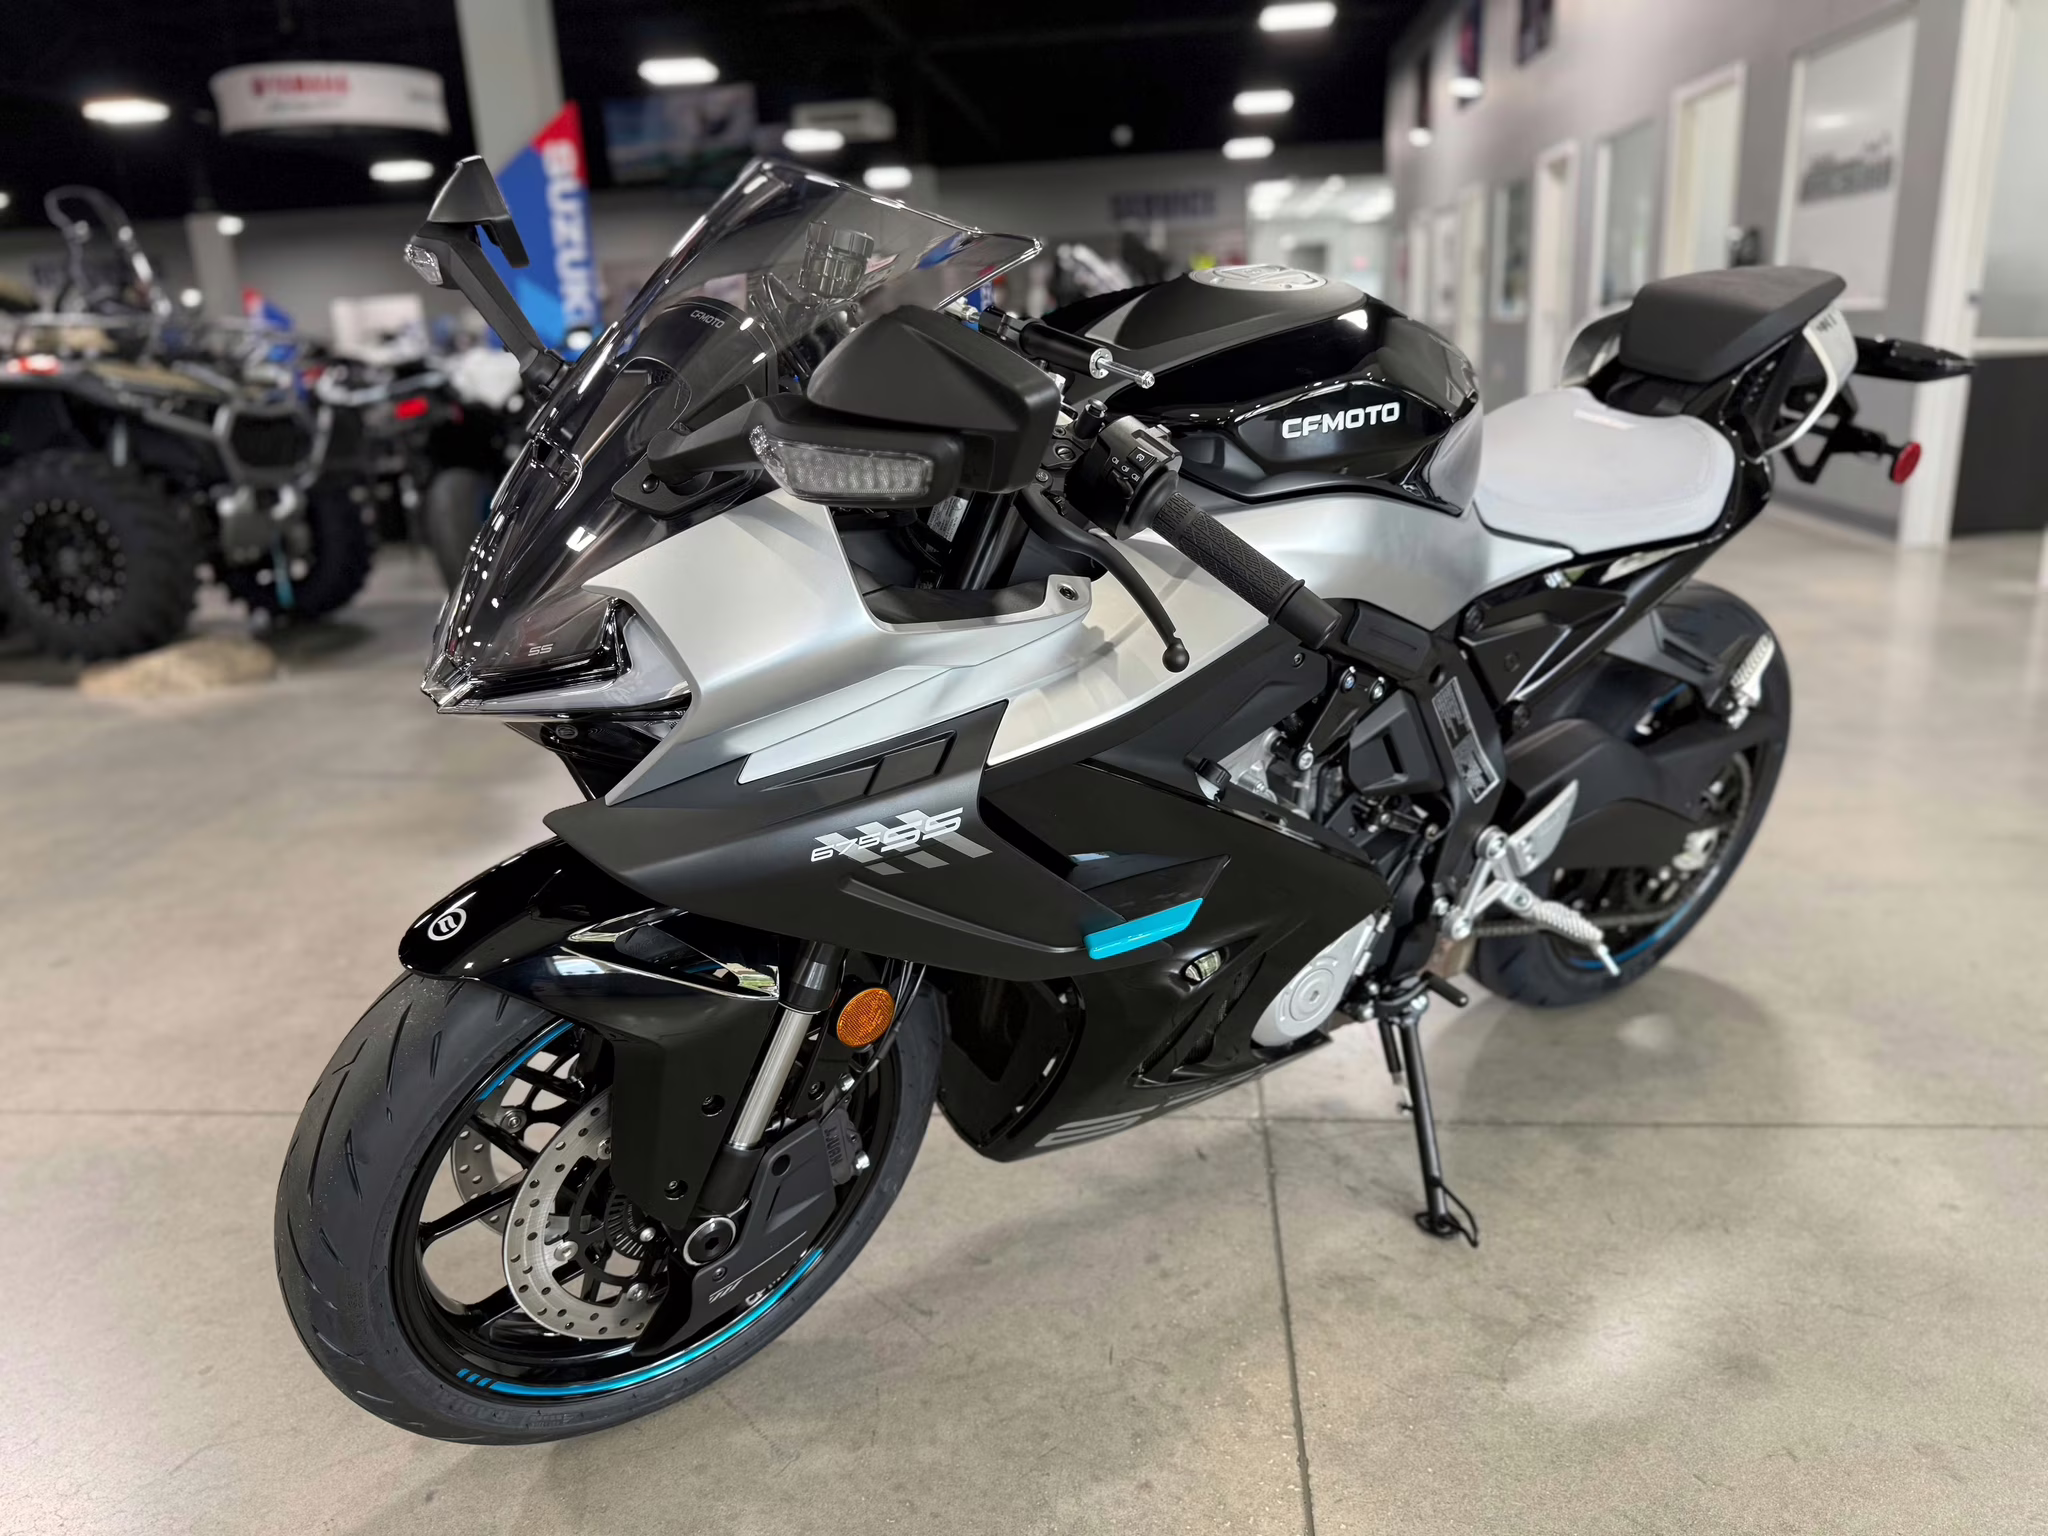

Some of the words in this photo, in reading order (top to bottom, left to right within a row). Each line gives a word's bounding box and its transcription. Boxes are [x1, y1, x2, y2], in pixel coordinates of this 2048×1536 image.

[690, 310, 725, 329] CFMOTO
[1281, 402, 1400, 439] CFMOTO
[527, 643, 554, 657] SS
